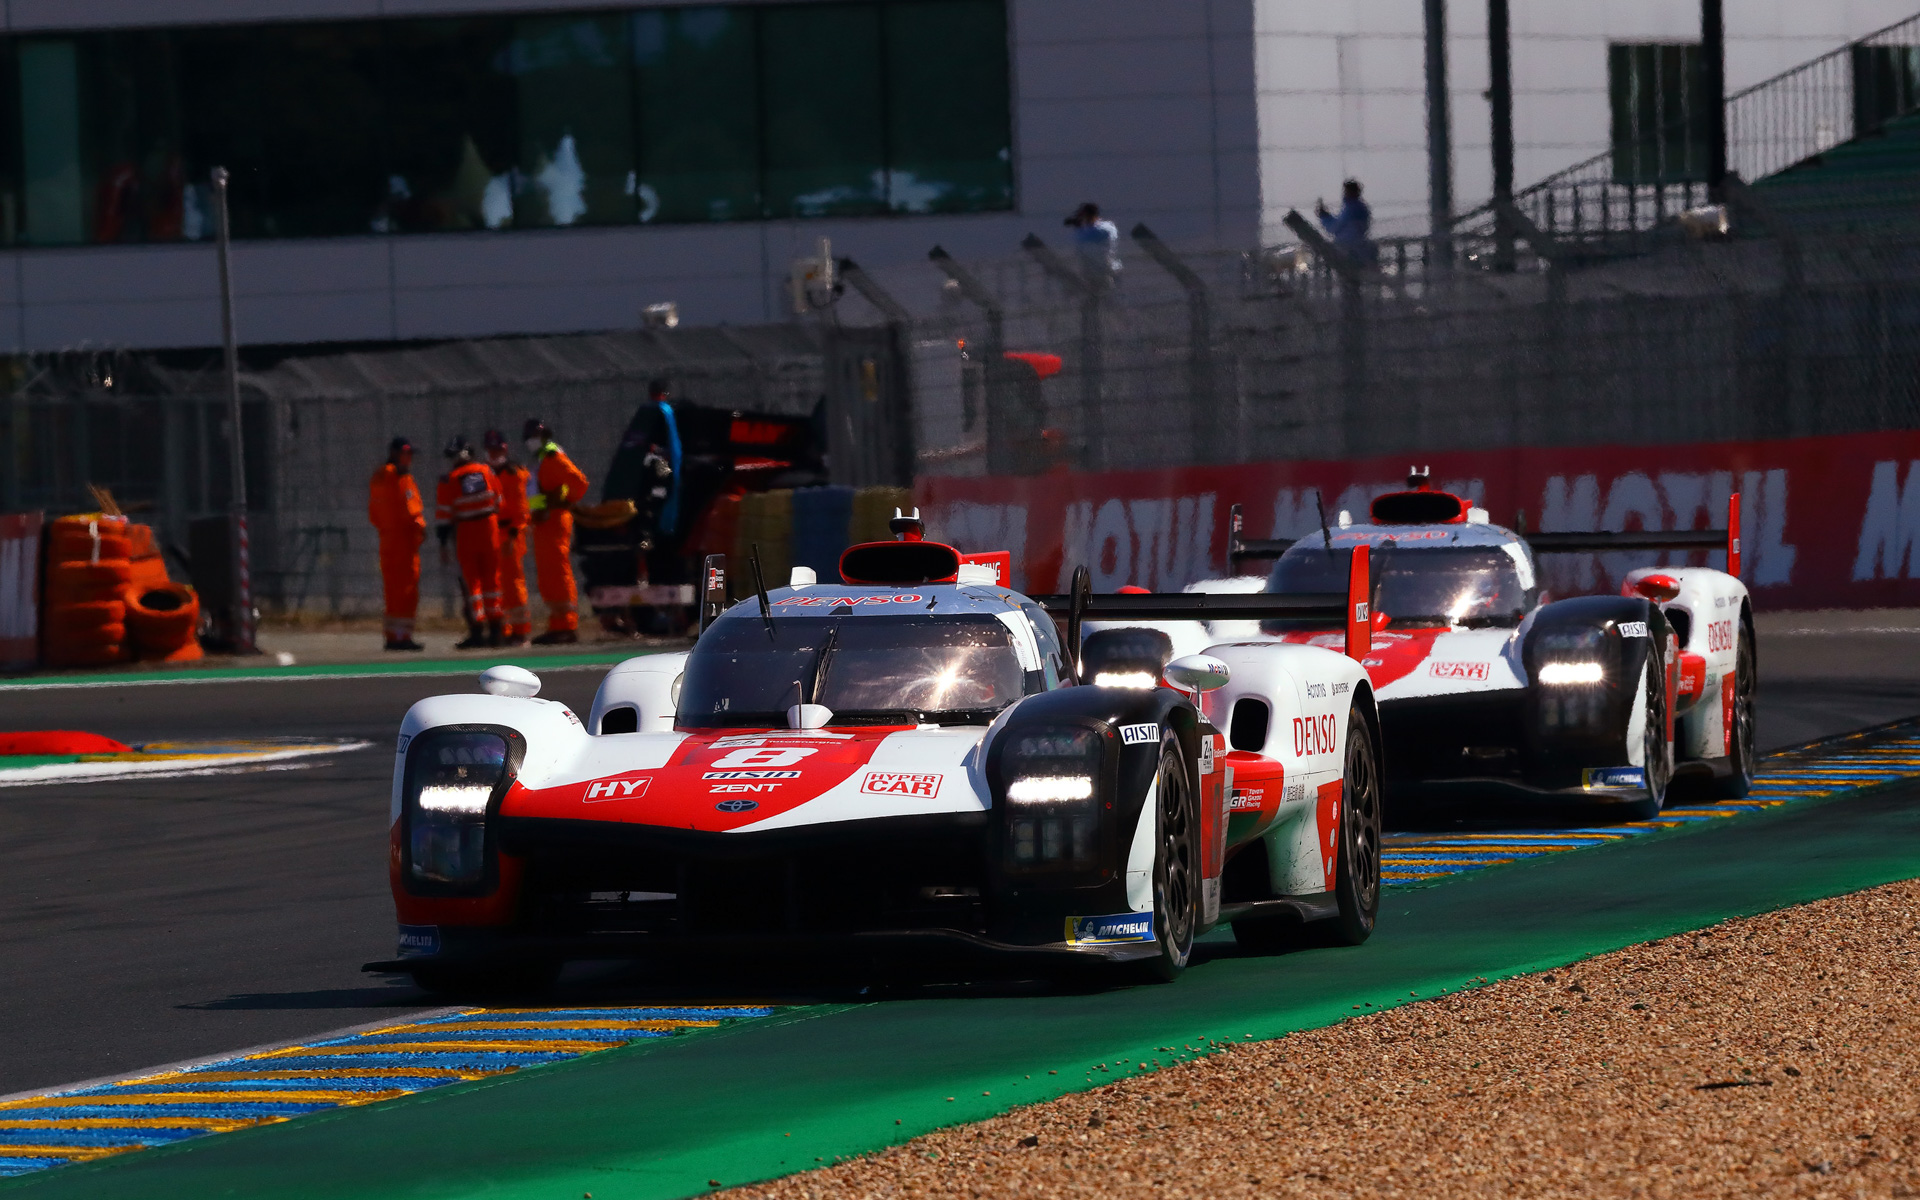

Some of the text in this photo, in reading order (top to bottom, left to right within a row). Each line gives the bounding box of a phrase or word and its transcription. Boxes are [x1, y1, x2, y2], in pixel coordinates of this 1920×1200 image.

[771, 594, 922, 607] DENSO
[1124, 726, 1158, 742] AISIN
[1292, 714, 1336, 757] DENSO
[711, 747, 819, 768] 8
[705, 771, 797, 779] AISIN
[871, 774, 936, 782] HYPER
[588, 780, 648, 798] HY
[709, 783, 782, 793] ZENT
[867, 780, 933, 795] CAR
[1230, 796, 1247, 807] GR
[1098, 921, 1149, 936] MICHELIN
